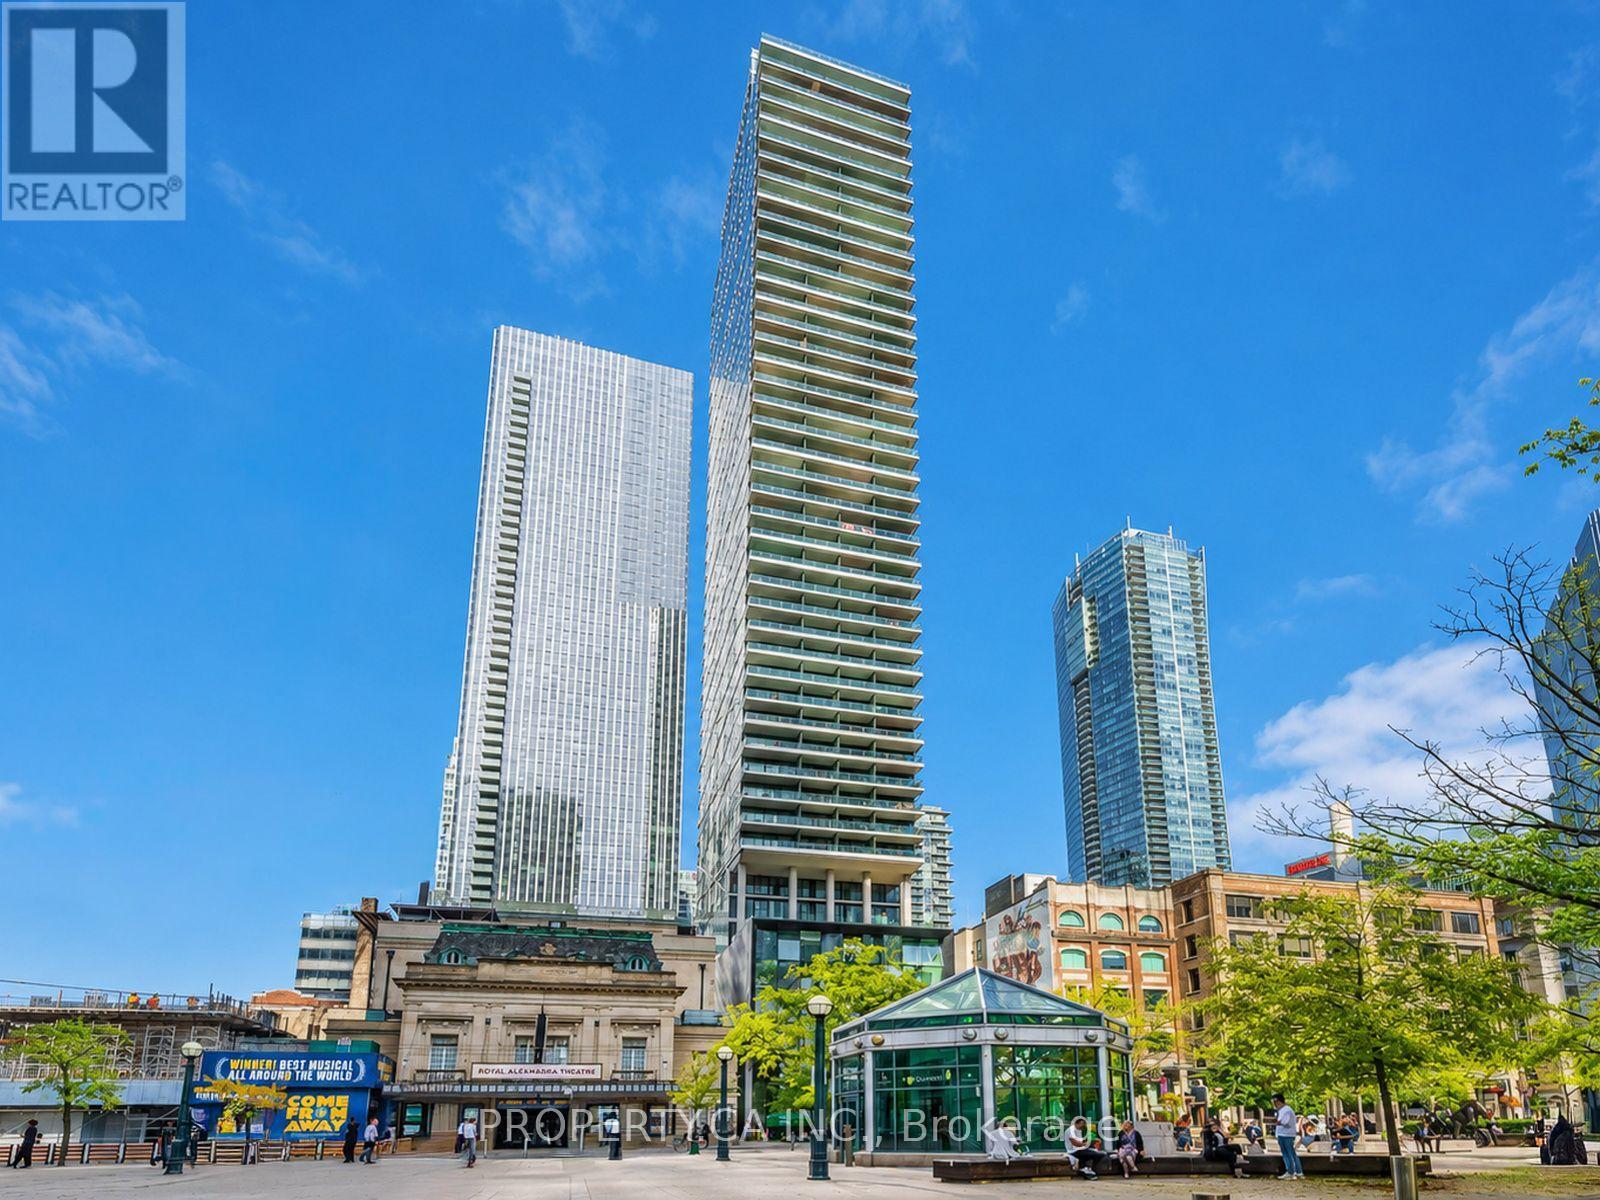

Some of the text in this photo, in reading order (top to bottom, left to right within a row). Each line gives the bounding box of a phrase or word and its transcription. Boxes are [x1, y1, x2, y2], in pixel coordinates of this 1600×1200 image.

[279, 1060, 305, 1070] BEST
[308, 1060, 354, 1071] MUSICAL
[228, 1070, 352, 1081] ALL AROUND THE WORLD
[287, 1095, 349, 1107] COME
[284, 1119, 347, 1132] AWAY
